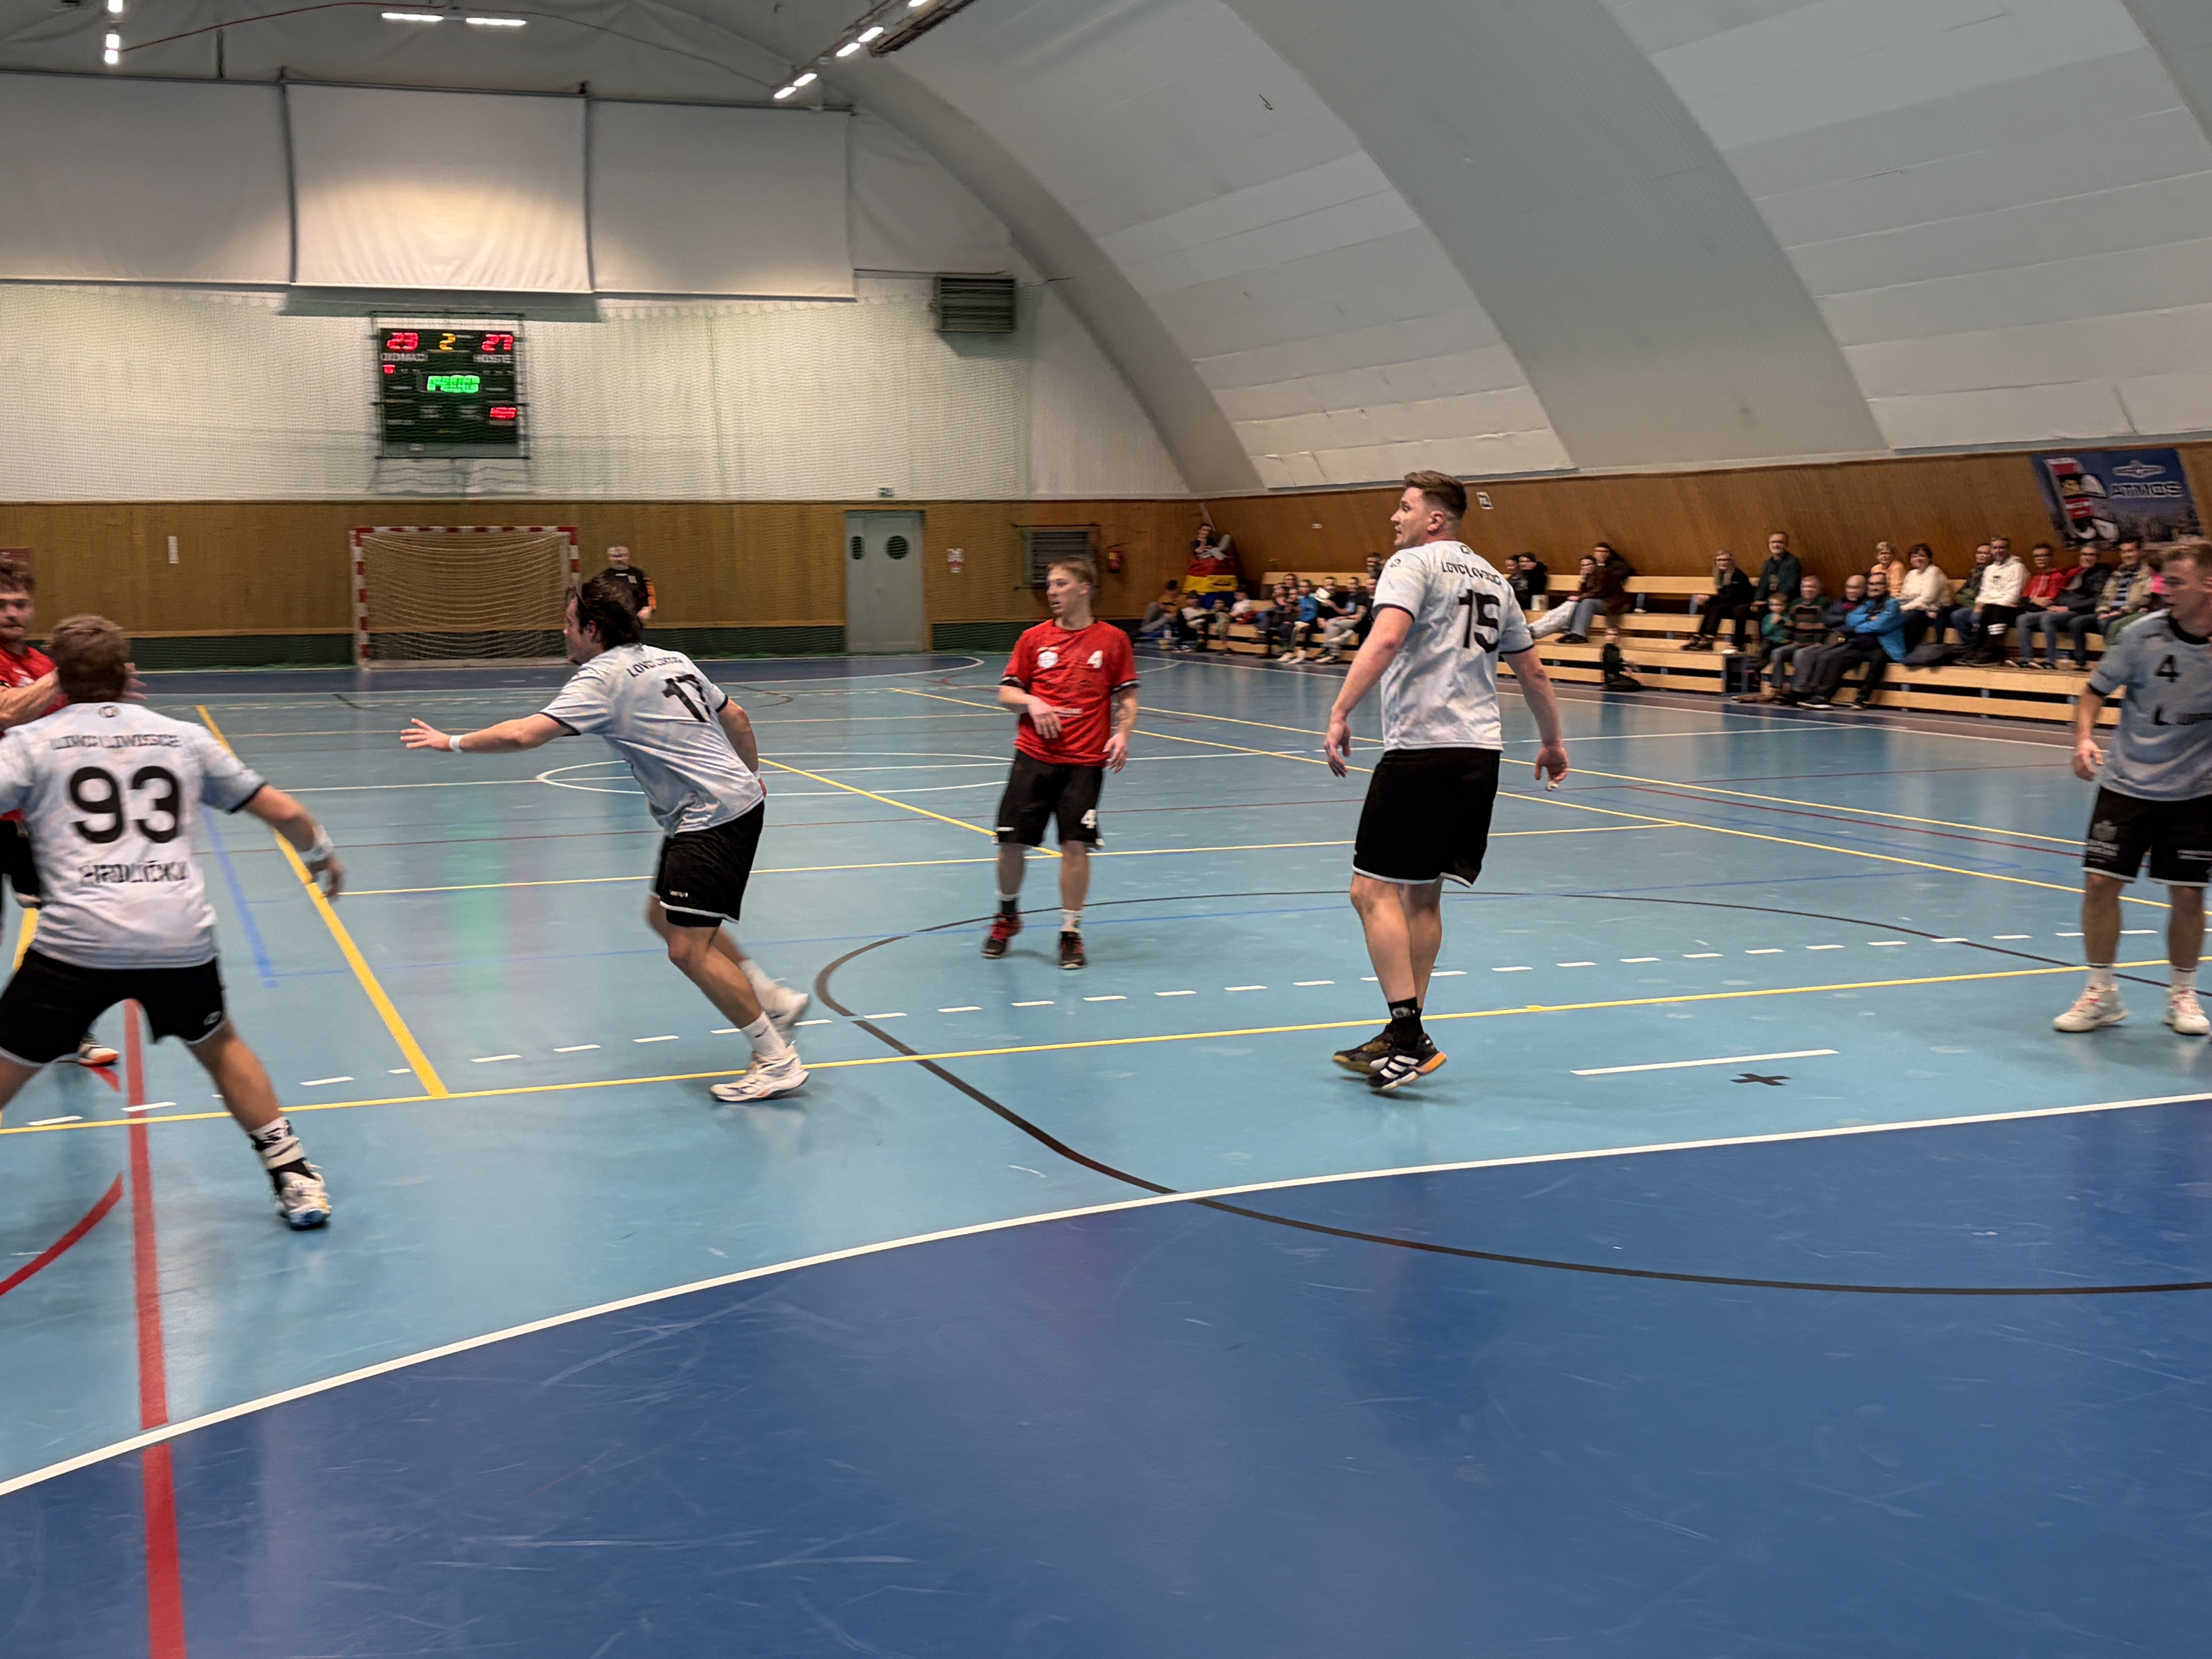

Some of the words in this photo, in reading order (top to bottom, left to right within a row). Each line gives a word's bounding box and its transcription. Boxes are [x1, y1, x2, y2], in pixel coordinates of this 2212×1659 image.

[439, 333, 456, 351] 2
[481, 334, 514, 351] 27
[1459, 588, 1501, 654] 15
[1087, 650, 1103, 668] 4
[2154, 654, 2181, 684] 4
[661, 674, 711, 723] 17
[69, 766, 182, 844] 93
[1080, 809, 1097, 829] 4
